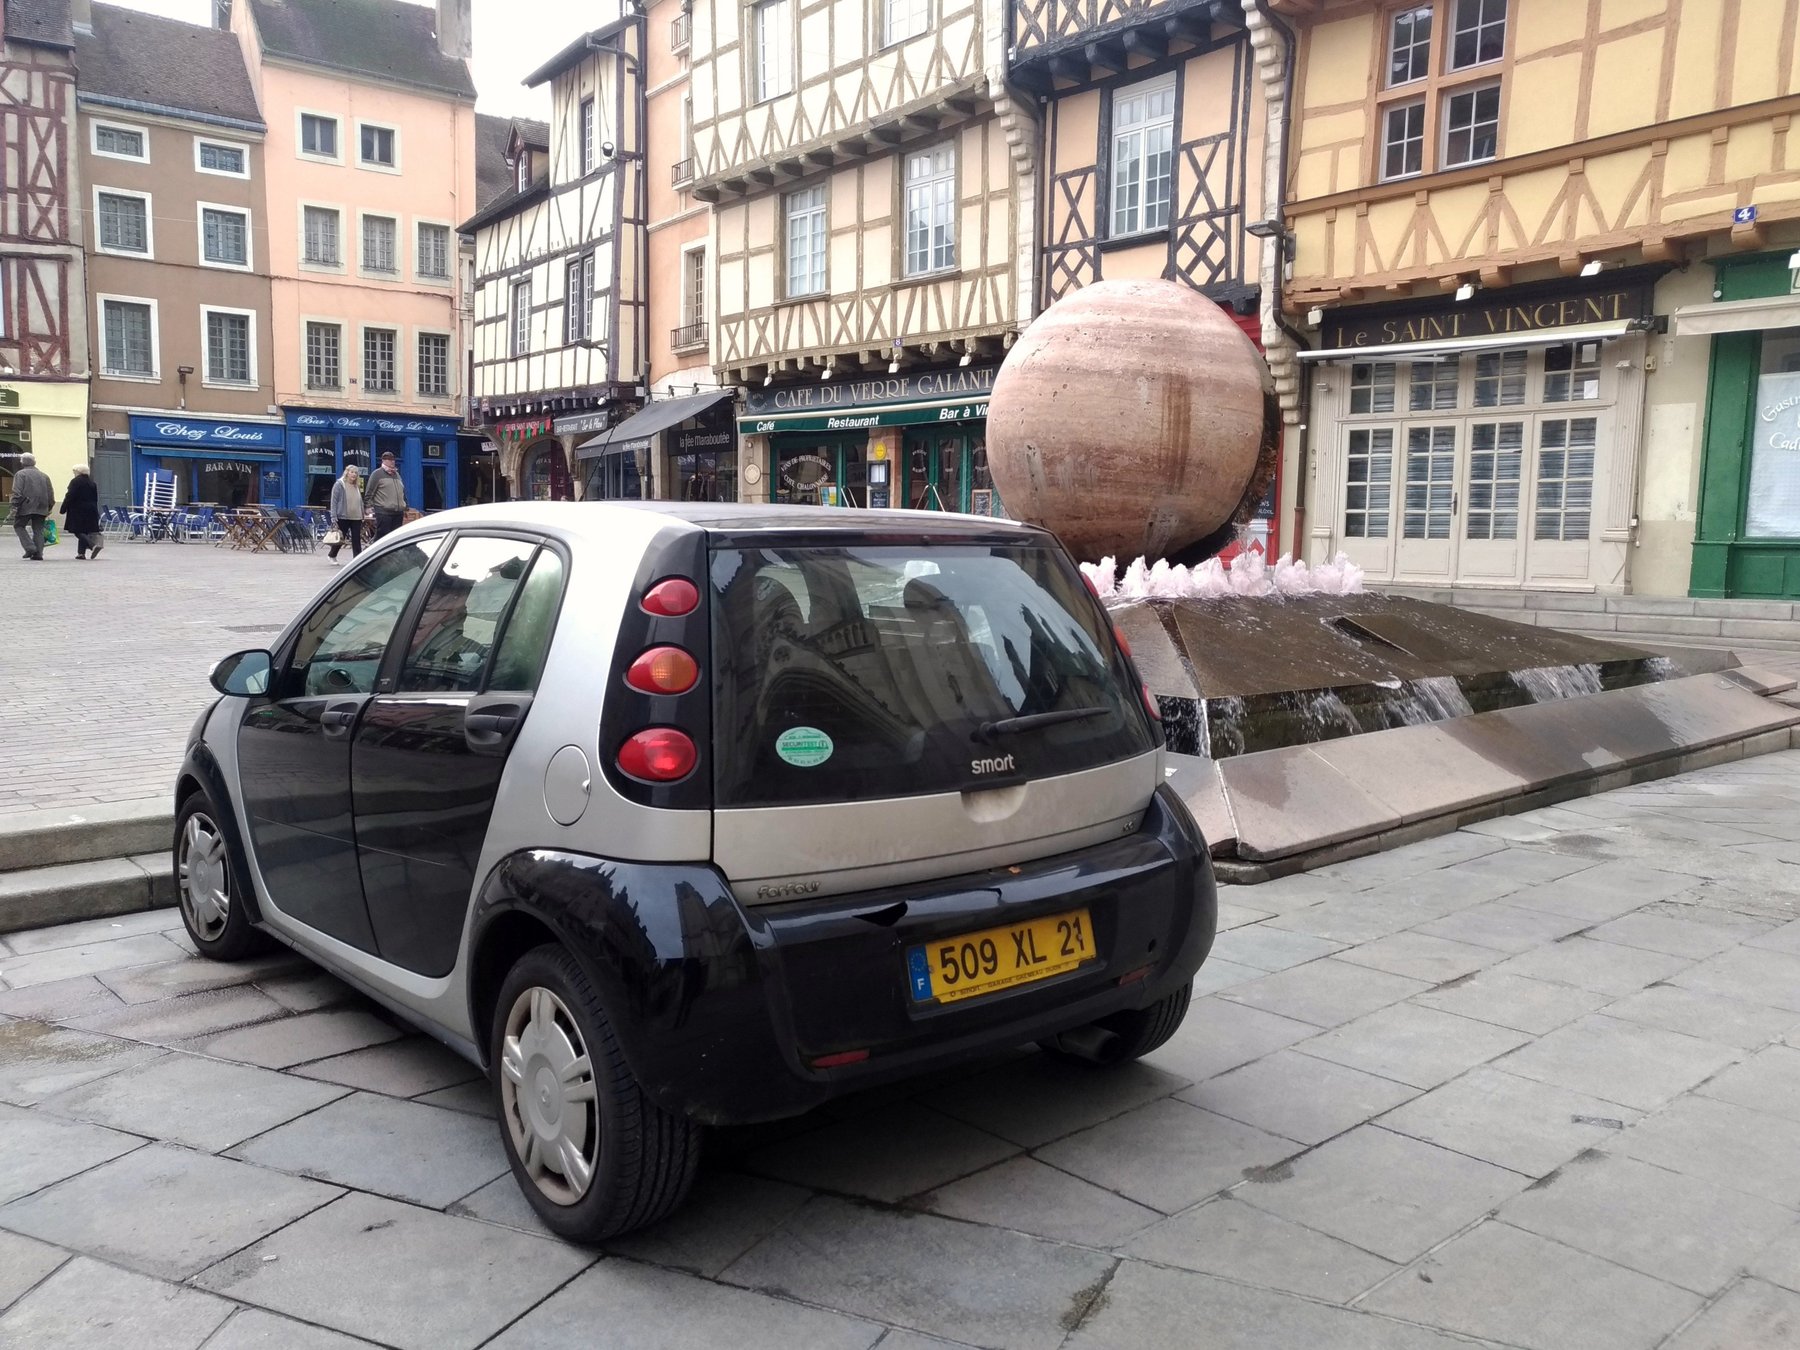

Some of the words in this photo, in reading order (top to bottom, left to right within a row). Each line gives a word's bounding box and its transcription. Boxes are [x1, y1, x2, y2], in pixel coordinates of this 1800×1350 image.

[1738, 208, 1752, 220] 4
[1336, 327, 1368, 348] Le
[1381, 312, 1465, 344] SAINT
[1484, 292, 1628, 333] VINCENT
[774, 388, 813, 408] CAFE
[821, 385, 842, 405] DU
[849, 378, 910, 402] VERRE
[917, 368, 994, 396] GALANT
[296, 415, 326, 425] Bar
[336, 417, 362, 427] Vin
[375, 419, 404, 432] Chez
[756, 421, 775, 432] Café
[827, 415, 880, 428] Restaurant
[938, 408, 960, 420] Bar
[963, 405, 971, 418] à
[155, 421, 208, 440] Chez
[211, 425, 263, 440] Louis
[205, 463, 225, 473] BAR
[226, 462, 234, 471] A
[234, 462, 253, 475] VIN
[971, 753, 1015, 774] smart
[757, 881, 820, 899] forfour
[940, 938, 998, 985] 509
[1011, 928, 1047, 969] XL
[1057, 916, 1085, 957] 21
[917, 977, 925, 991] F
